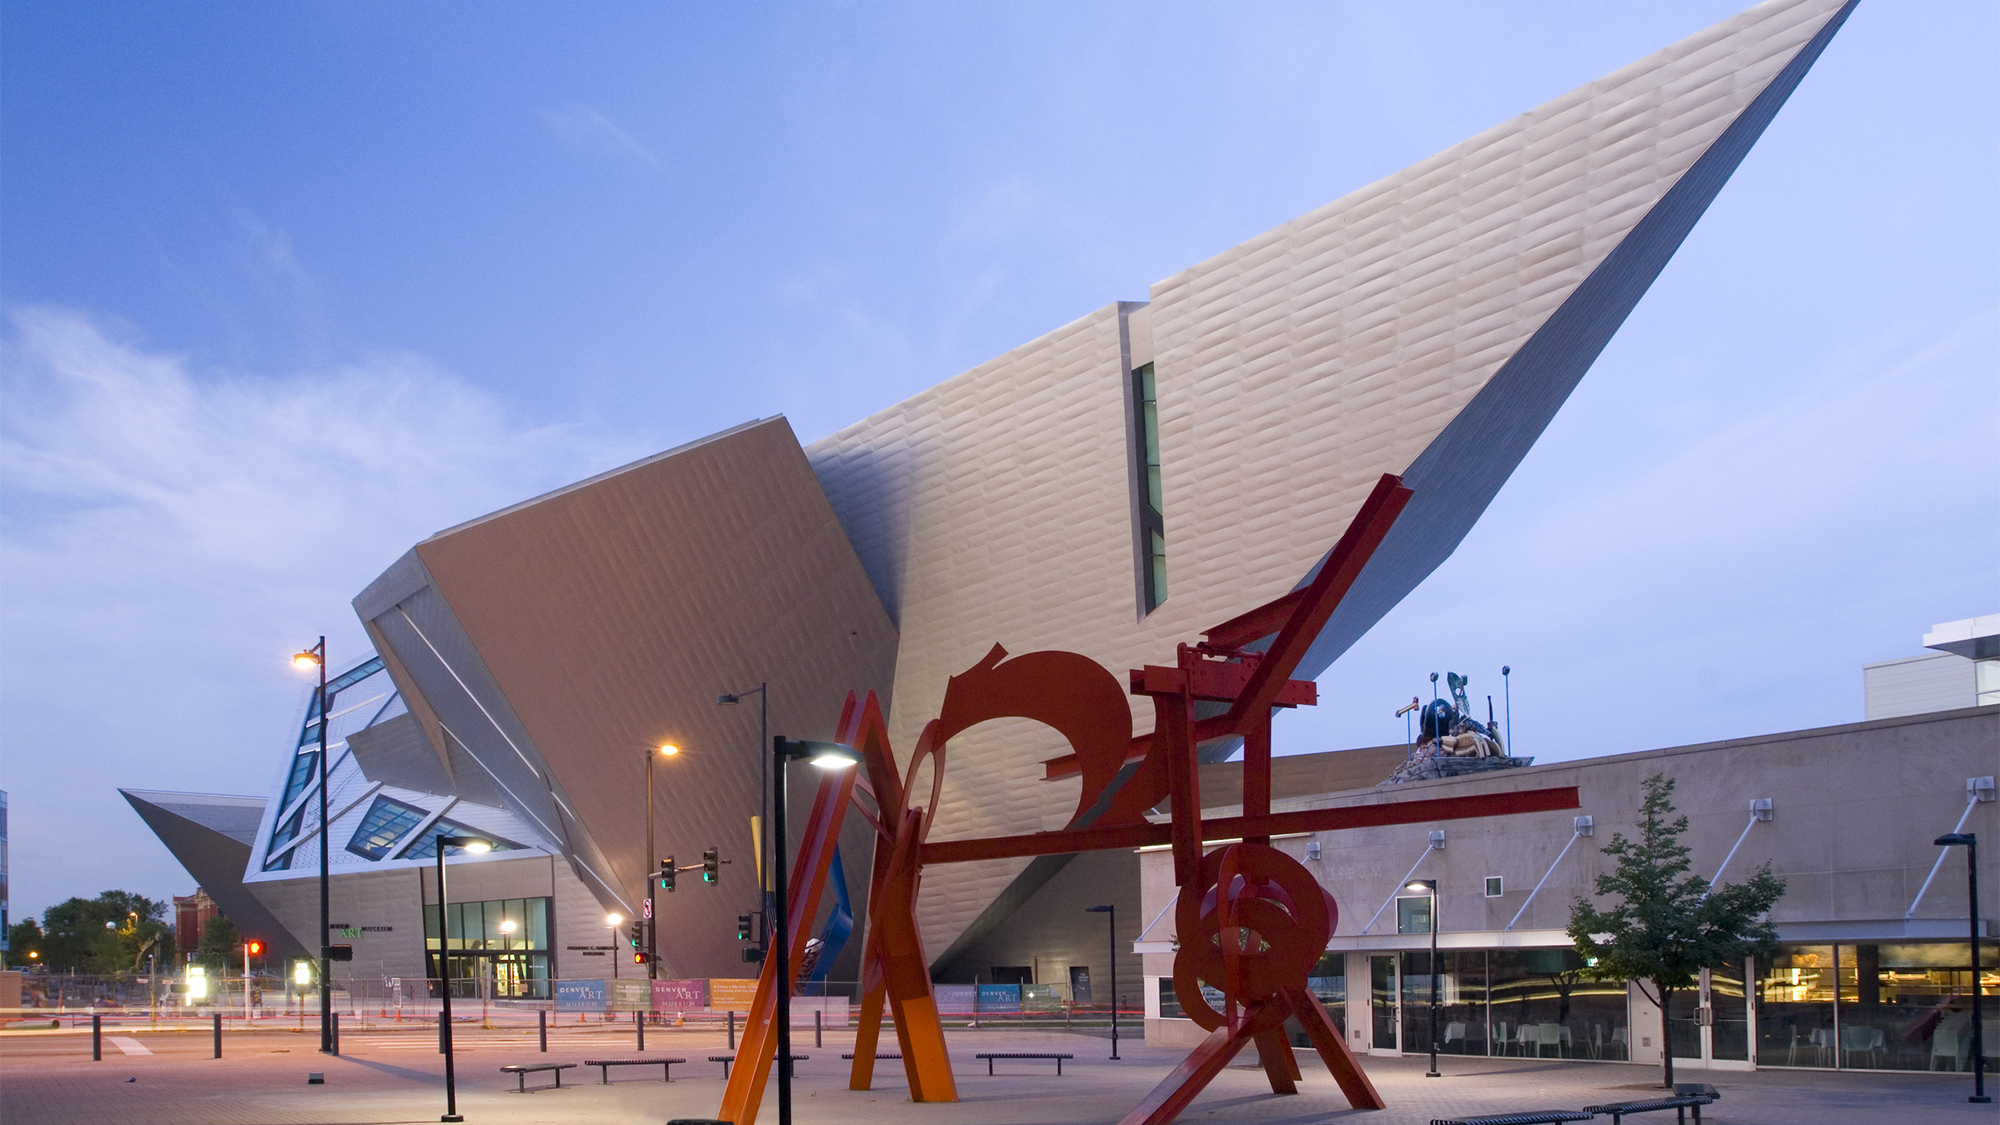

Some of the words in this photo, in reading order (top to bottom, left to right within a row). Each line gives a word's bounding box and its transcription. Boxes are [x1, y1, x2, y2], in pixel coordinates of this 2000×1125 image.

[340, 928, 362, 938] ART
[579, 990, 603, 999] ART
[675, 990, 700, 999] ART
[998, 993, 1018, 1002] ART
